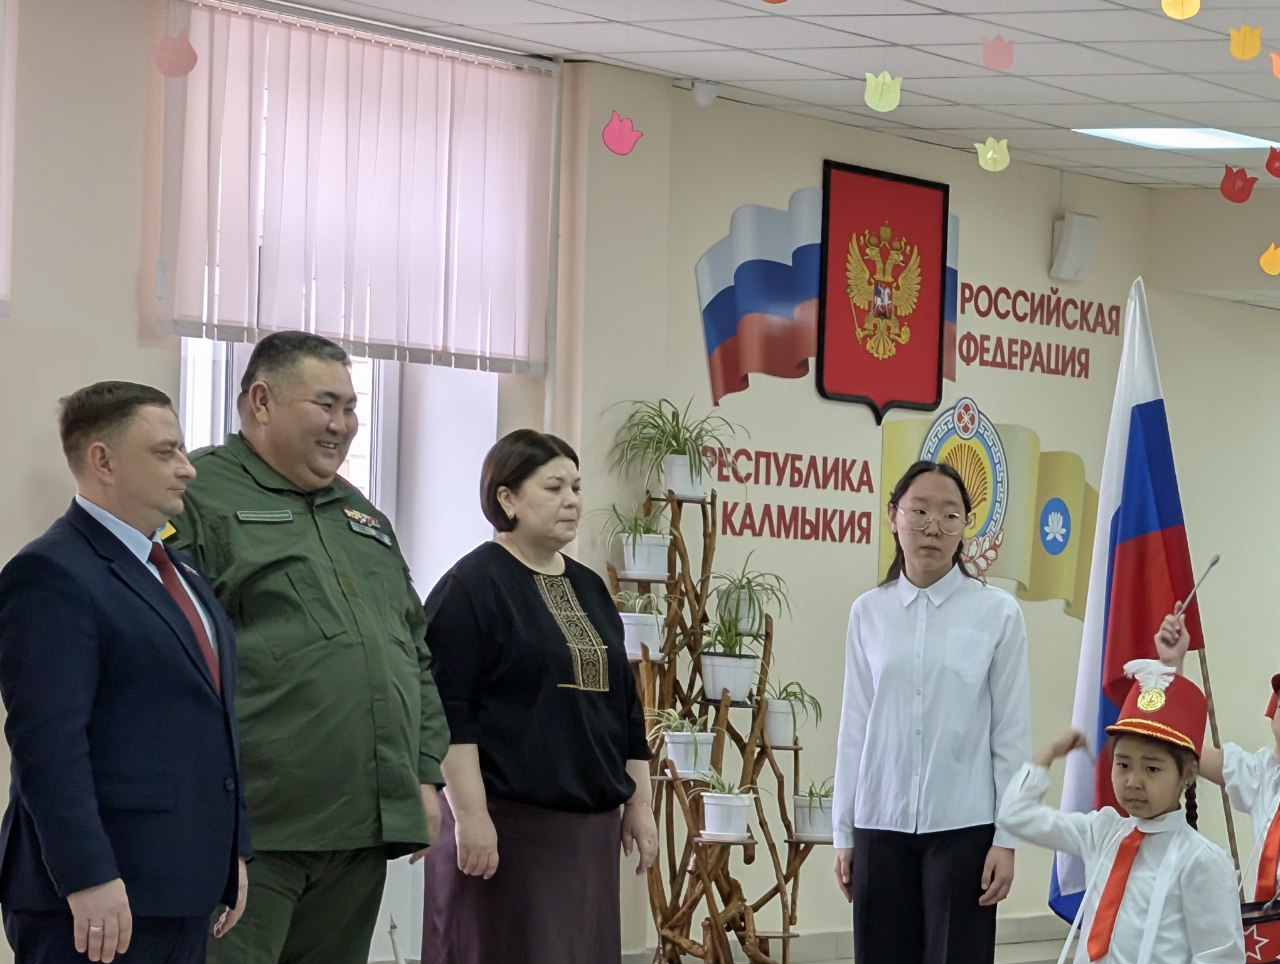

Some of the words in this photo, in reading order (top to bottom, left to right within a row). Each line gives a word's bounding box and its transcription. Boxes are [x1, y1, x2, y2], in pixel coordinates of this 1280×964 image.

[960, 282, 1121, 336] РОССИЙСКАЯ
[958, 331, 1090, 379] ФЕДЕРАЦИЯ
[701, 444, 874, 494] РЕСПУБЛИКА
[721, 500, 872, 544] КАЛМЫКИЯ
